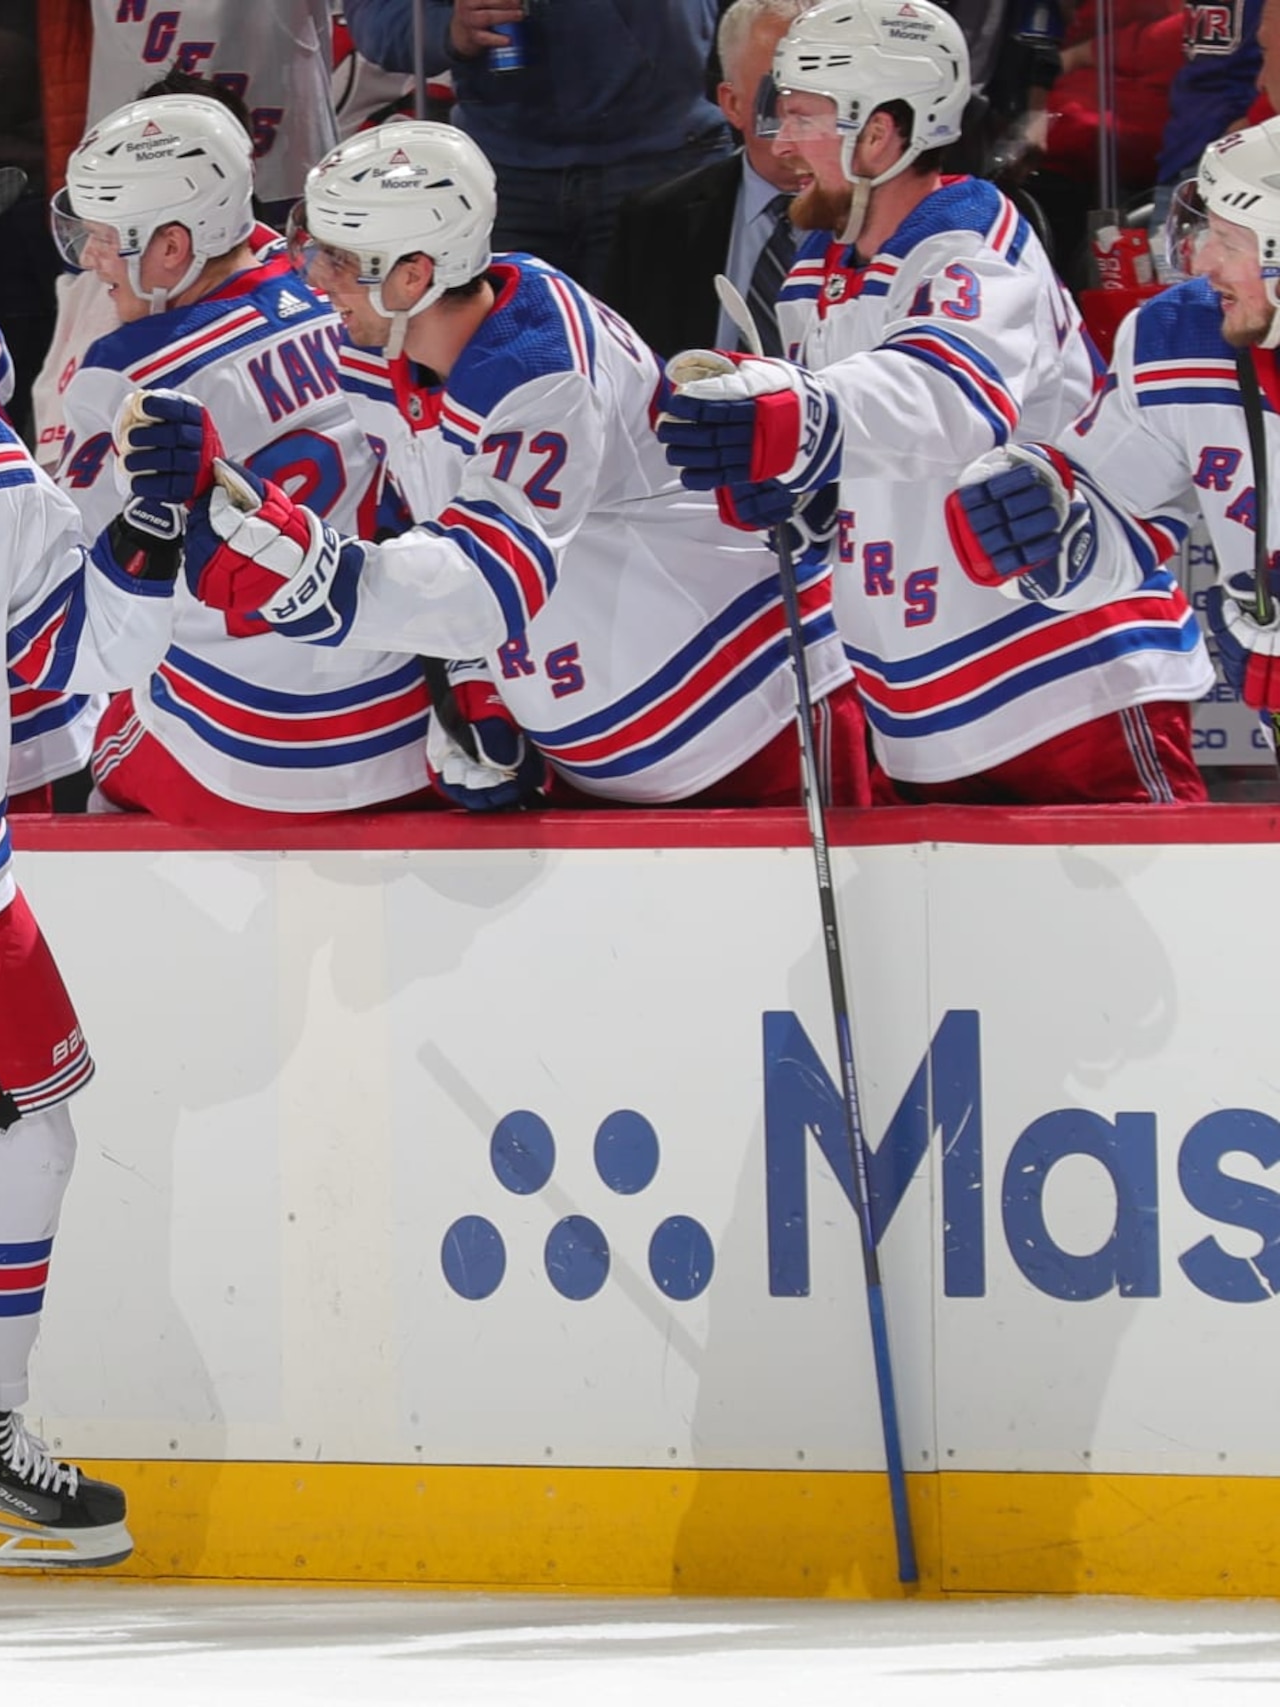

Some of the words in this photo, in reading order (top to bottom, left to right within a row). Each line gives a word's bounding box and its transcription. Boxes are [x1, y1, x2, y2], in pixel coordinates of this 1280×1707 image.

[881, 17, 935, 32] Benjamin
[889, 28, 928, 42] Moore
[126, 135, 180, 152] Benjamin
[136, 149, 174, 162] Moore
[381, 178, 422, 190] Moore
[908, 263, 981, 321] 13
[482, 430, 568, 510] 72
